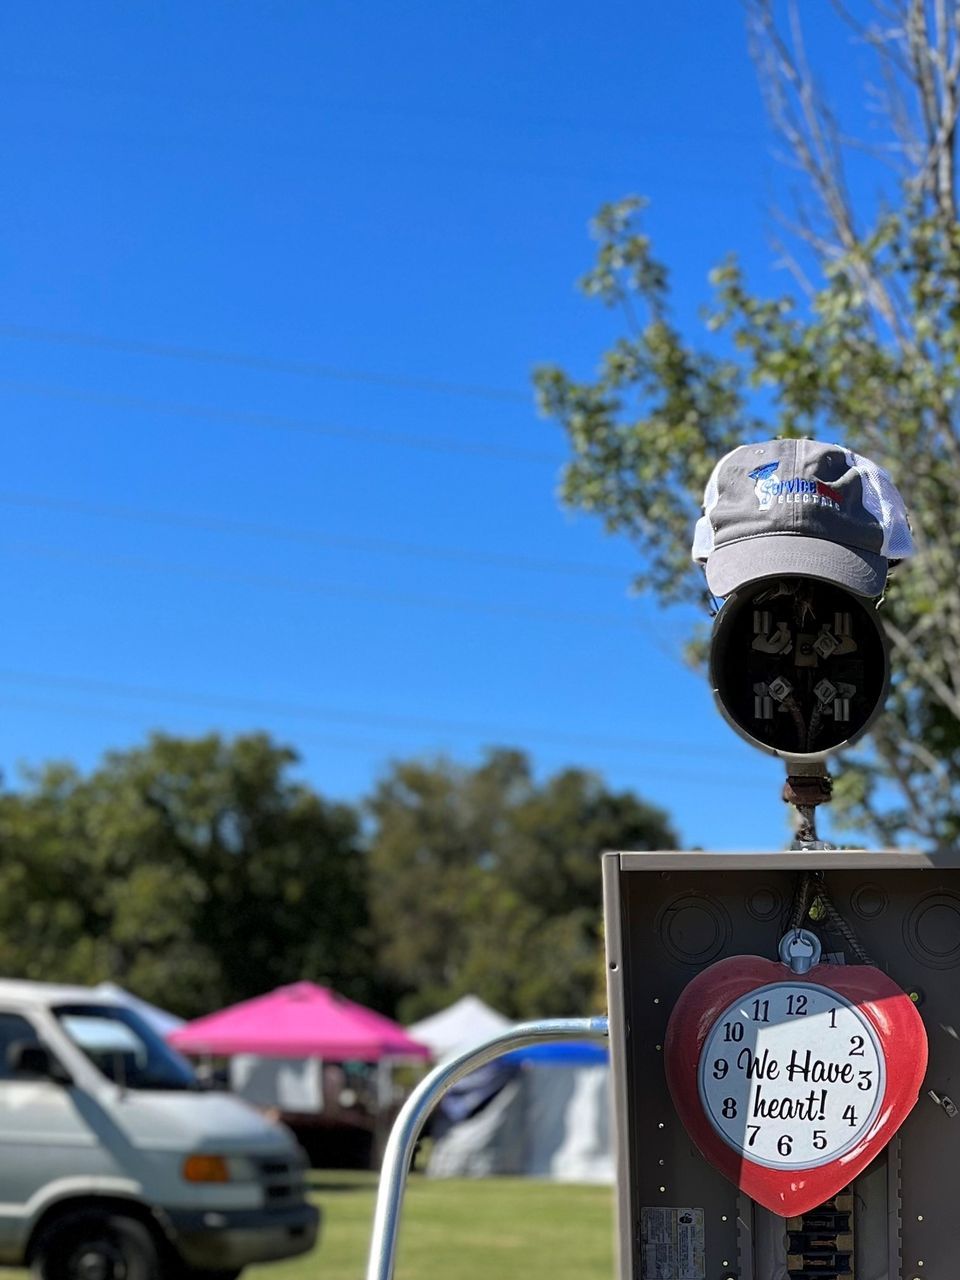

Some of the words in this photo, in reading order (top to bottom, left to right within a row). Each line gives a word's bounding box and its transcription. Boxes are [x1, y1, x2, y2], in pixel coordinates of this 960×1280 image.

[752, 999, 770, 1022] 11
[786, 994, 808, 1016] 12
[828, 1008, 838, 1029] 1
[723, 1021, 744, 1042] 10
[848, 1035, 865, 1057] 2
[712, 1058, 729, 1080] 9
[737, 1047, 780, 1080] We
[786, 1049, 855, 1084] Have
[857, 1070, 873, 1091] 3
[721, 1097, 738, 1119] 8
[753, 1084, 828, 1121] heart!
[841, 1104, 858, 1127] 4
[746, 1124, 761, 1147] 7
[777, 1134, 794, 1157] 6
[812, 1130, 828, 1150] 5
